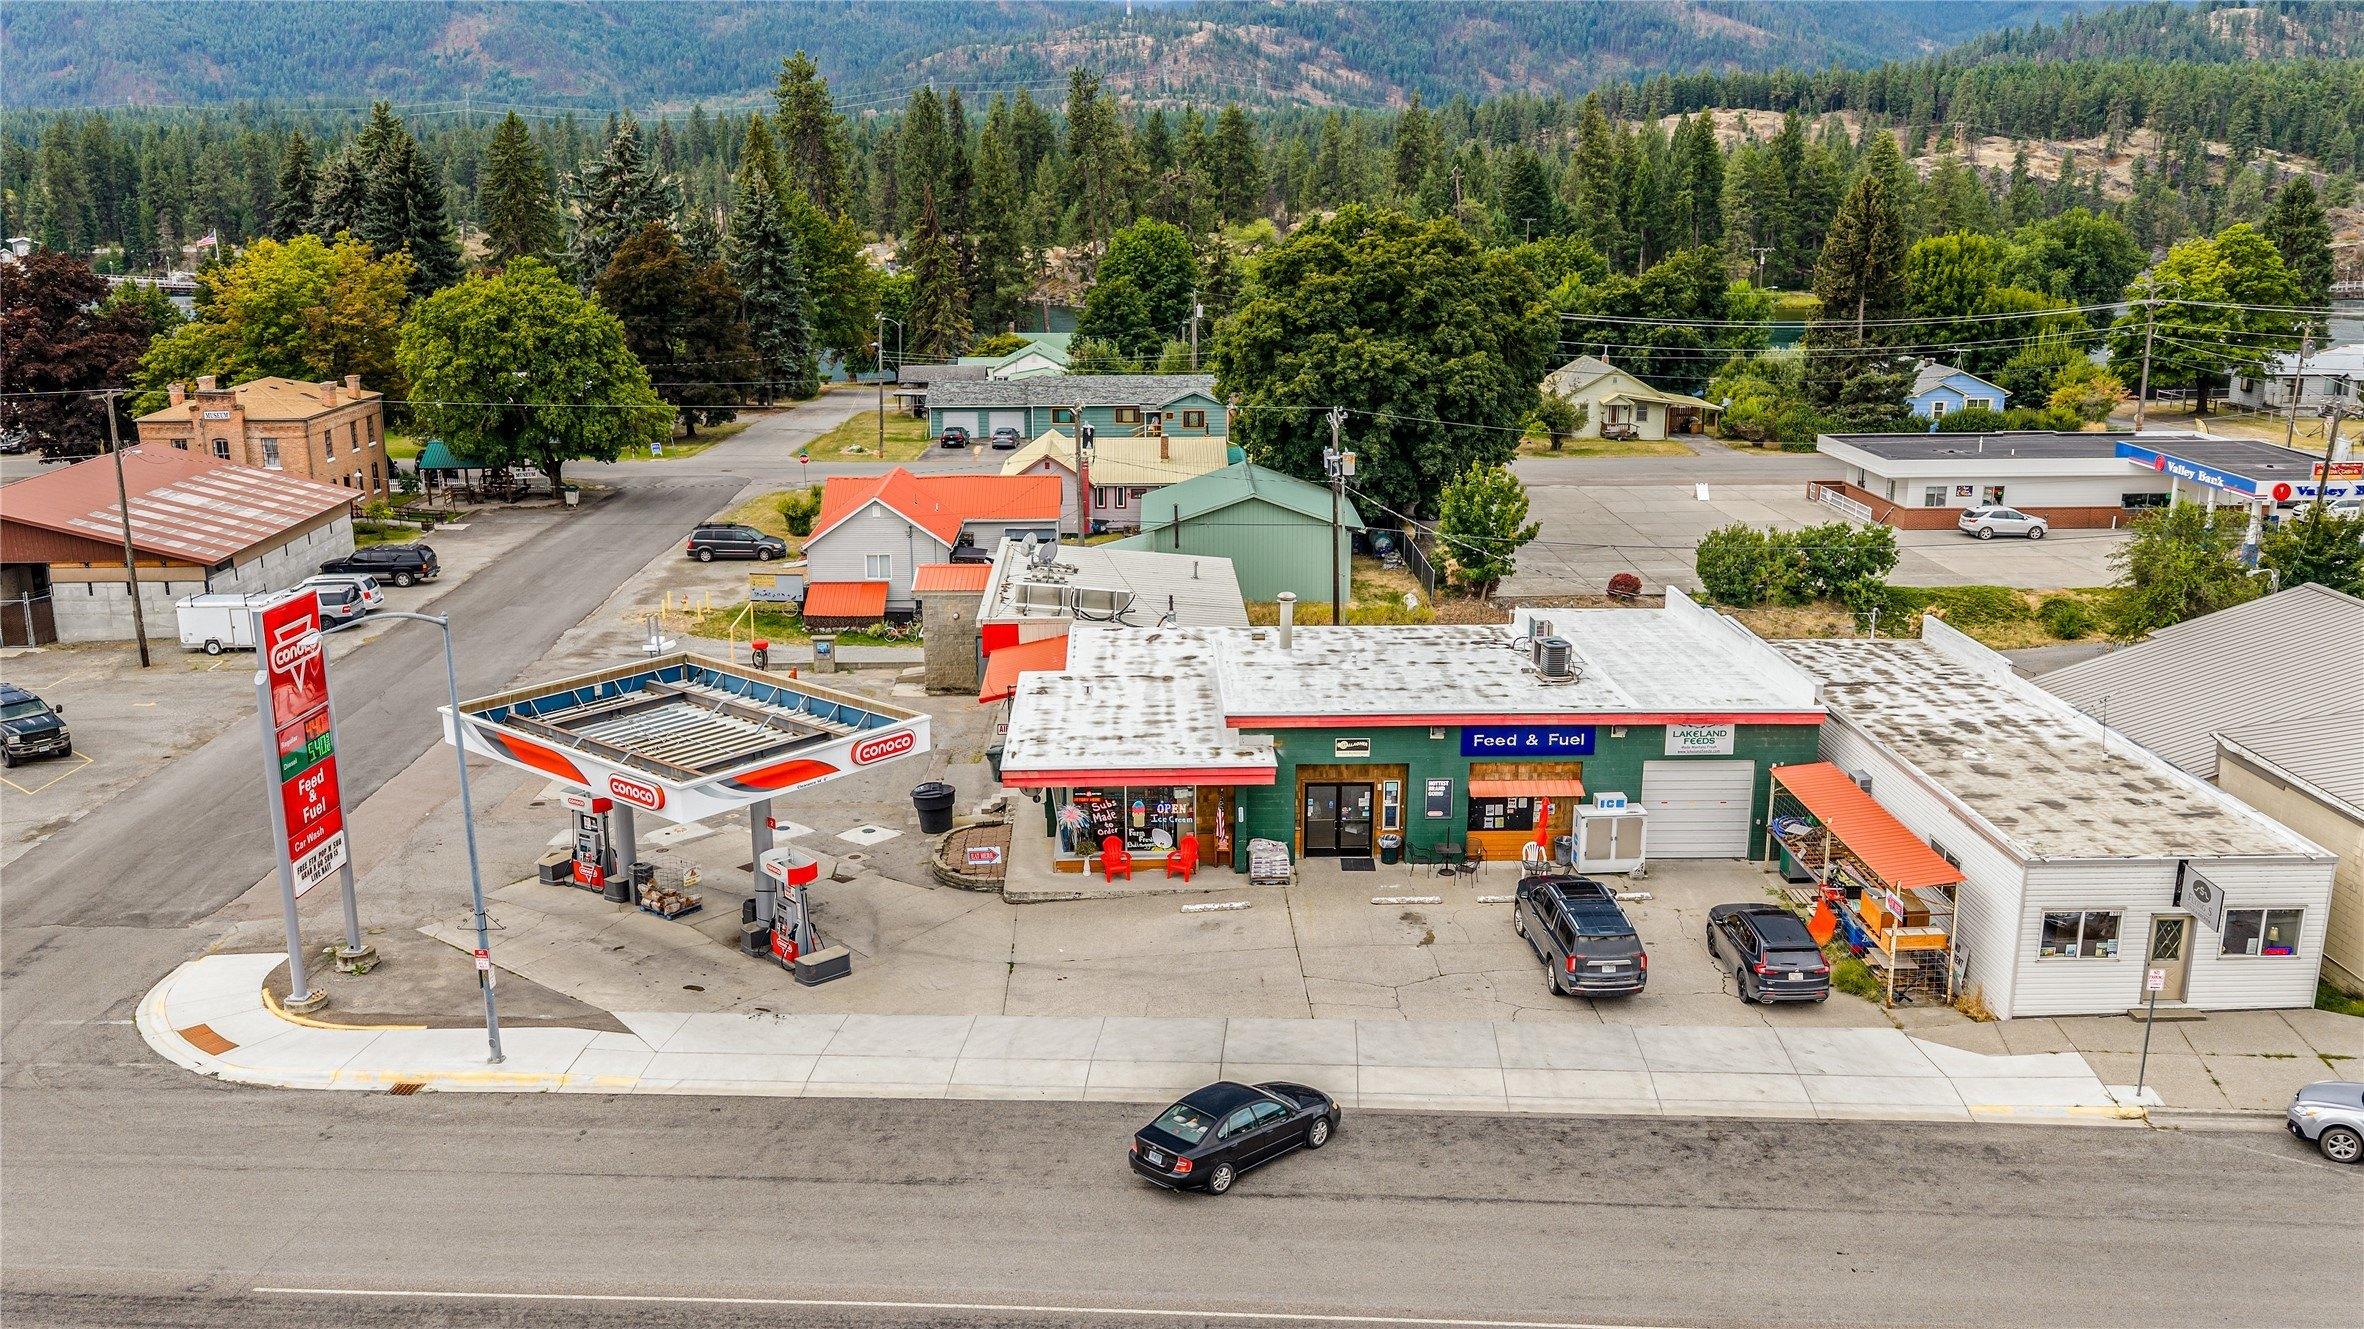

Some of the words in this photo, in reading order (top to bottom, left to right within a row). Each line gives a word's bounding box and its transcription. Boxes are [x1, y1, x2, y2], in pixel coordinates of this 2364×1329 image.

[2168, 461, 2195, 479] Valley
[2198, 470, 2224, 487] Bank
[1473, 734, 1517, 747] Feed
[1525, 734, 1539, 746] &
[1548, 733, 1585, 746] Fuel
[1672, 730, 1727, 738] LAKELAND
[1683, 737, 1715, 745] FEEDS
[298, 767, 325, 796] Feed
[309, 788, 317, 803] &
[303, 796, 326, 824] Fuel
[1091, 800, 1117, 811] Subs
[1156, 803, 1187, 814] OPEN
[1600, 799, 1625, 809] ICE
[1092, 810, 1117, 823] Made
[1150, 814, 1167, 823] Ice
[1097, 828, 1118, 836] Order
[294, 840, 306, 852] Car
[306, 826, 325, 844] Wash
